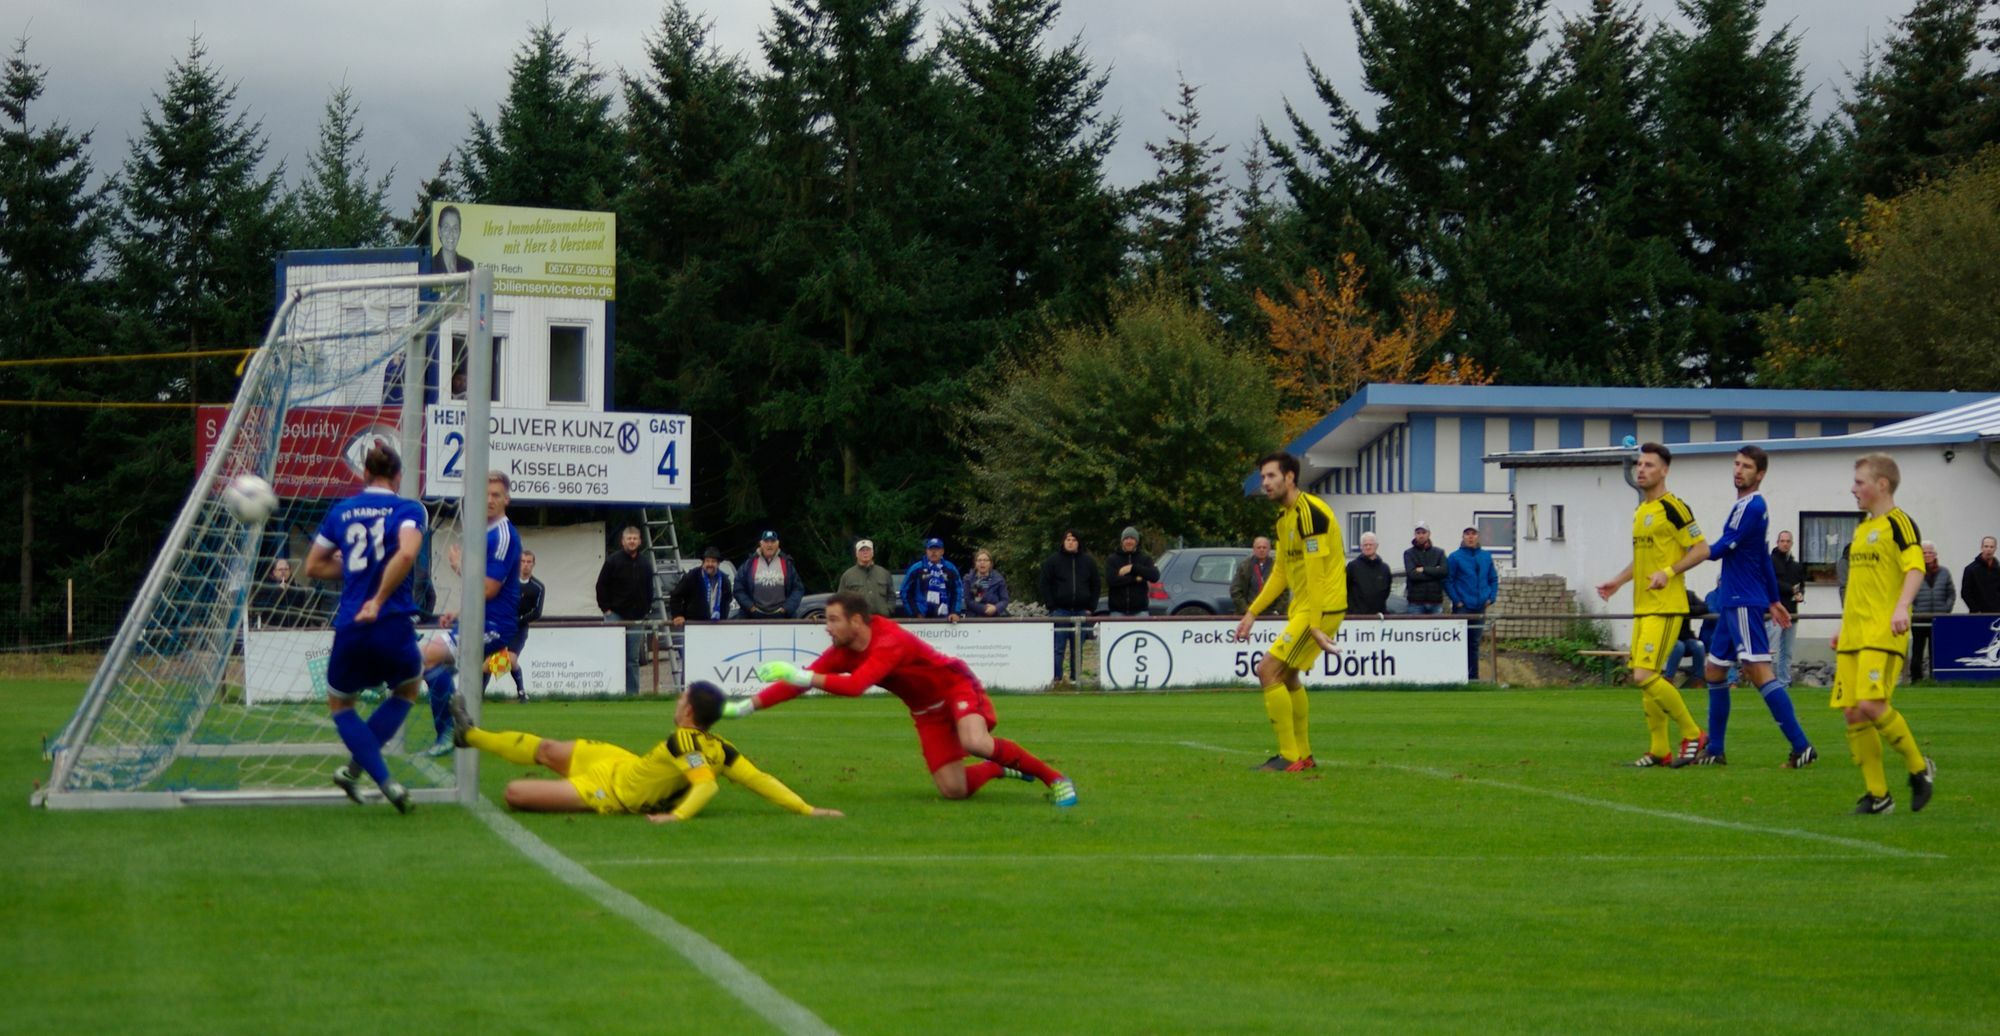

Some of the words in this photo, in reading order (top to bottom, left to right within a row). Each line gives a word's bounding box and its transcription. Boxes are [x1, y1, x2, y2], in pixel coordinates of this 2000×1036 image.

[483, 219, 504, 236] Ihre
[507, 217, 606, 235] Immobilienmaklerin
[503, 240, 521, 254] mit
[524, 238, 547, 254] Herz
[560, 236, 606, 251] Verstand
[501, 264, 524, 274] Rech
[283, 419, 340, 443] ecurity
[489, 417, 557, 437] OLIVER
[562, 419, 615, 439] KUNZ
[649, 419, 686, 435] GAST
[443, 431, 465, 478] 2
[657, 440, 679, 485] 4
[511, 459, 608, 477] KISSELBACH
[510, 481, 550, 493] 06766
[558, 482, 582, 494] 960
[585, 482, 609, 495] 763
[346, 518, 385, 573] 21
[1356, 628, 1375, 642] im
[1381, 627, 1461, 642] Hunsrück
[531, 660, 568, 669] Kirchweg
[1324, 649, 1395, 677] Dörth
[713, 666, 762, 683] VIA
